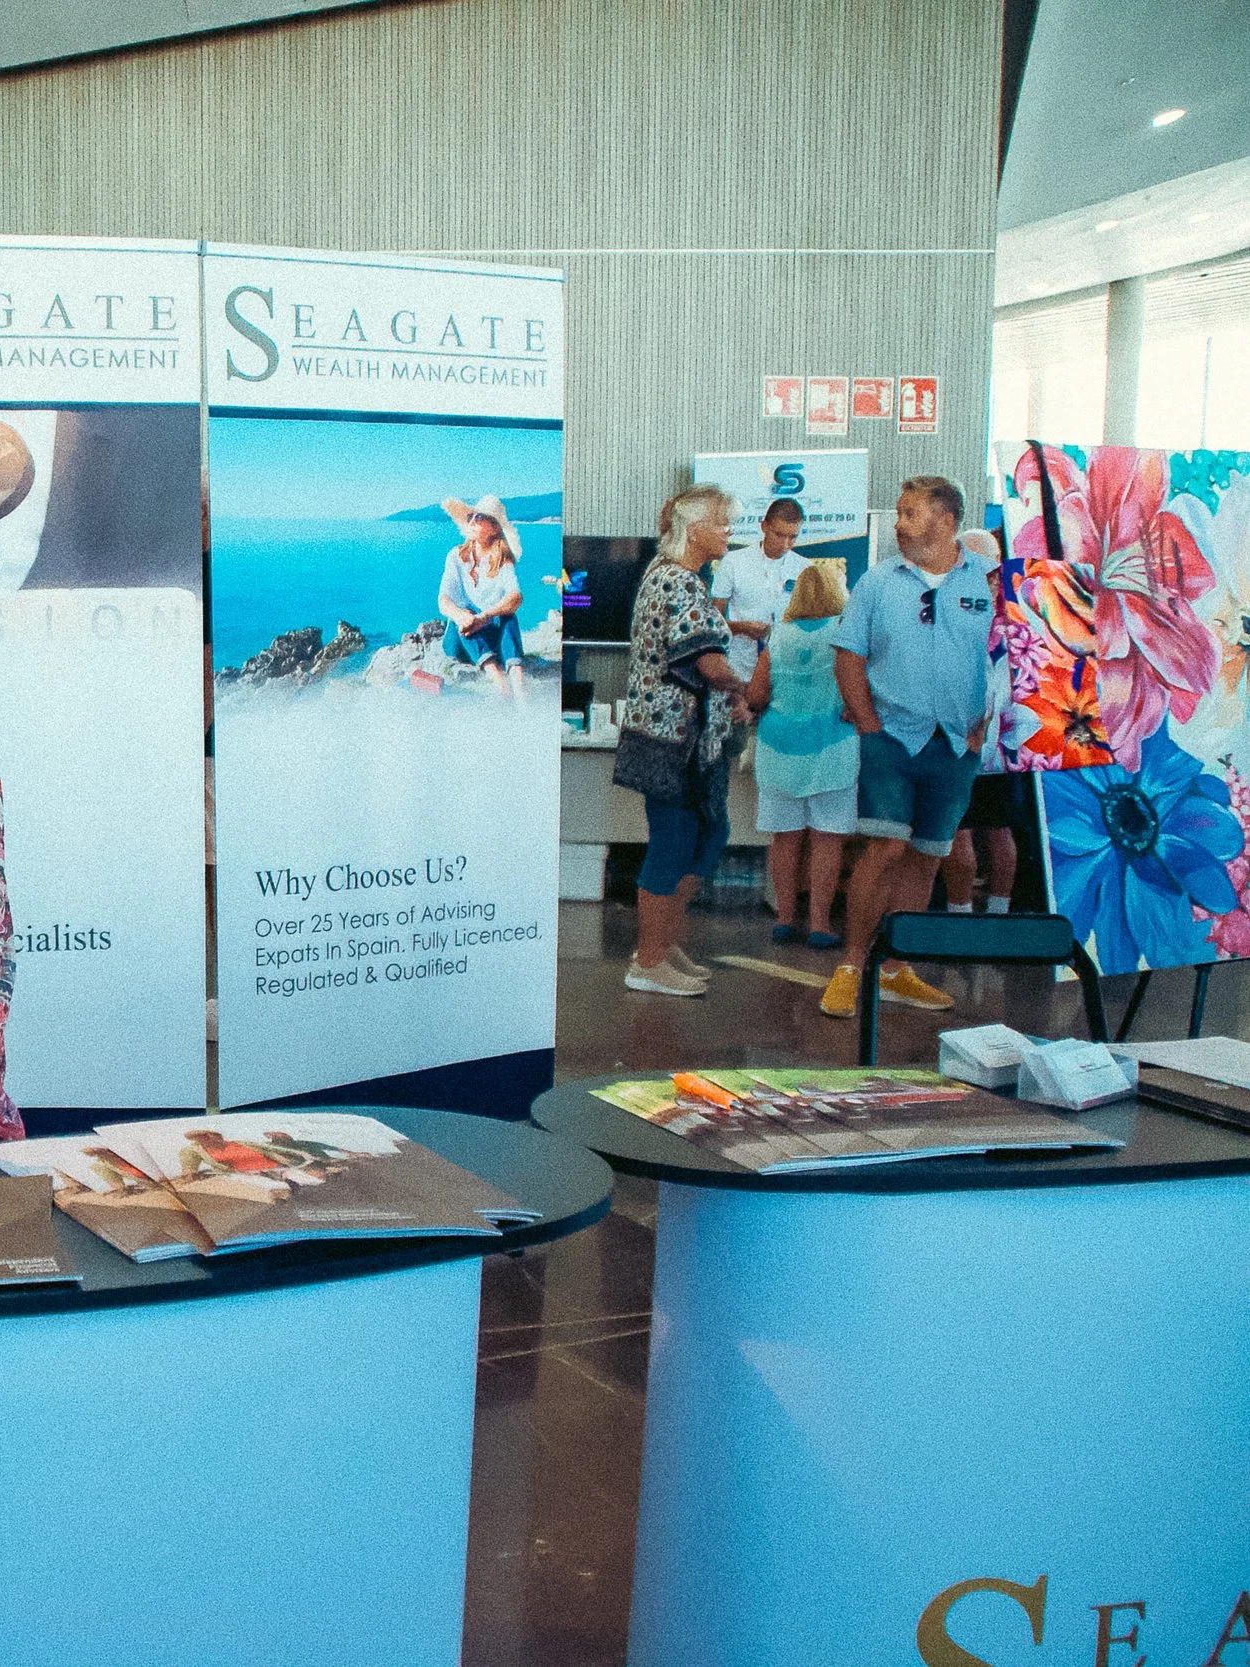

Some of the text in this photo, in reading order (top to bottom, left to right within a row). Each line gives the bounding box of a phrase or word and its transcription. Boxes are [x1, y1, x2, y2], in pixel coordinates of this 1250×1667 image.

[224, 285, 546, 383] SEAGATE
[292, 356, 547, 387] WEALTH MANAGEMENT
[254, 855, 468, 901] Why Choose Us?
[255, 900, 496, 938] Over 25 Years of Advising
[13, 924, 112, 953] cialists
[255, 944, 320, 969] Expats
[326, 941, 342, 961] In
[412, 931, 449, 953] Fully
[255, 955, 468, 997] Regulated & Qualified
